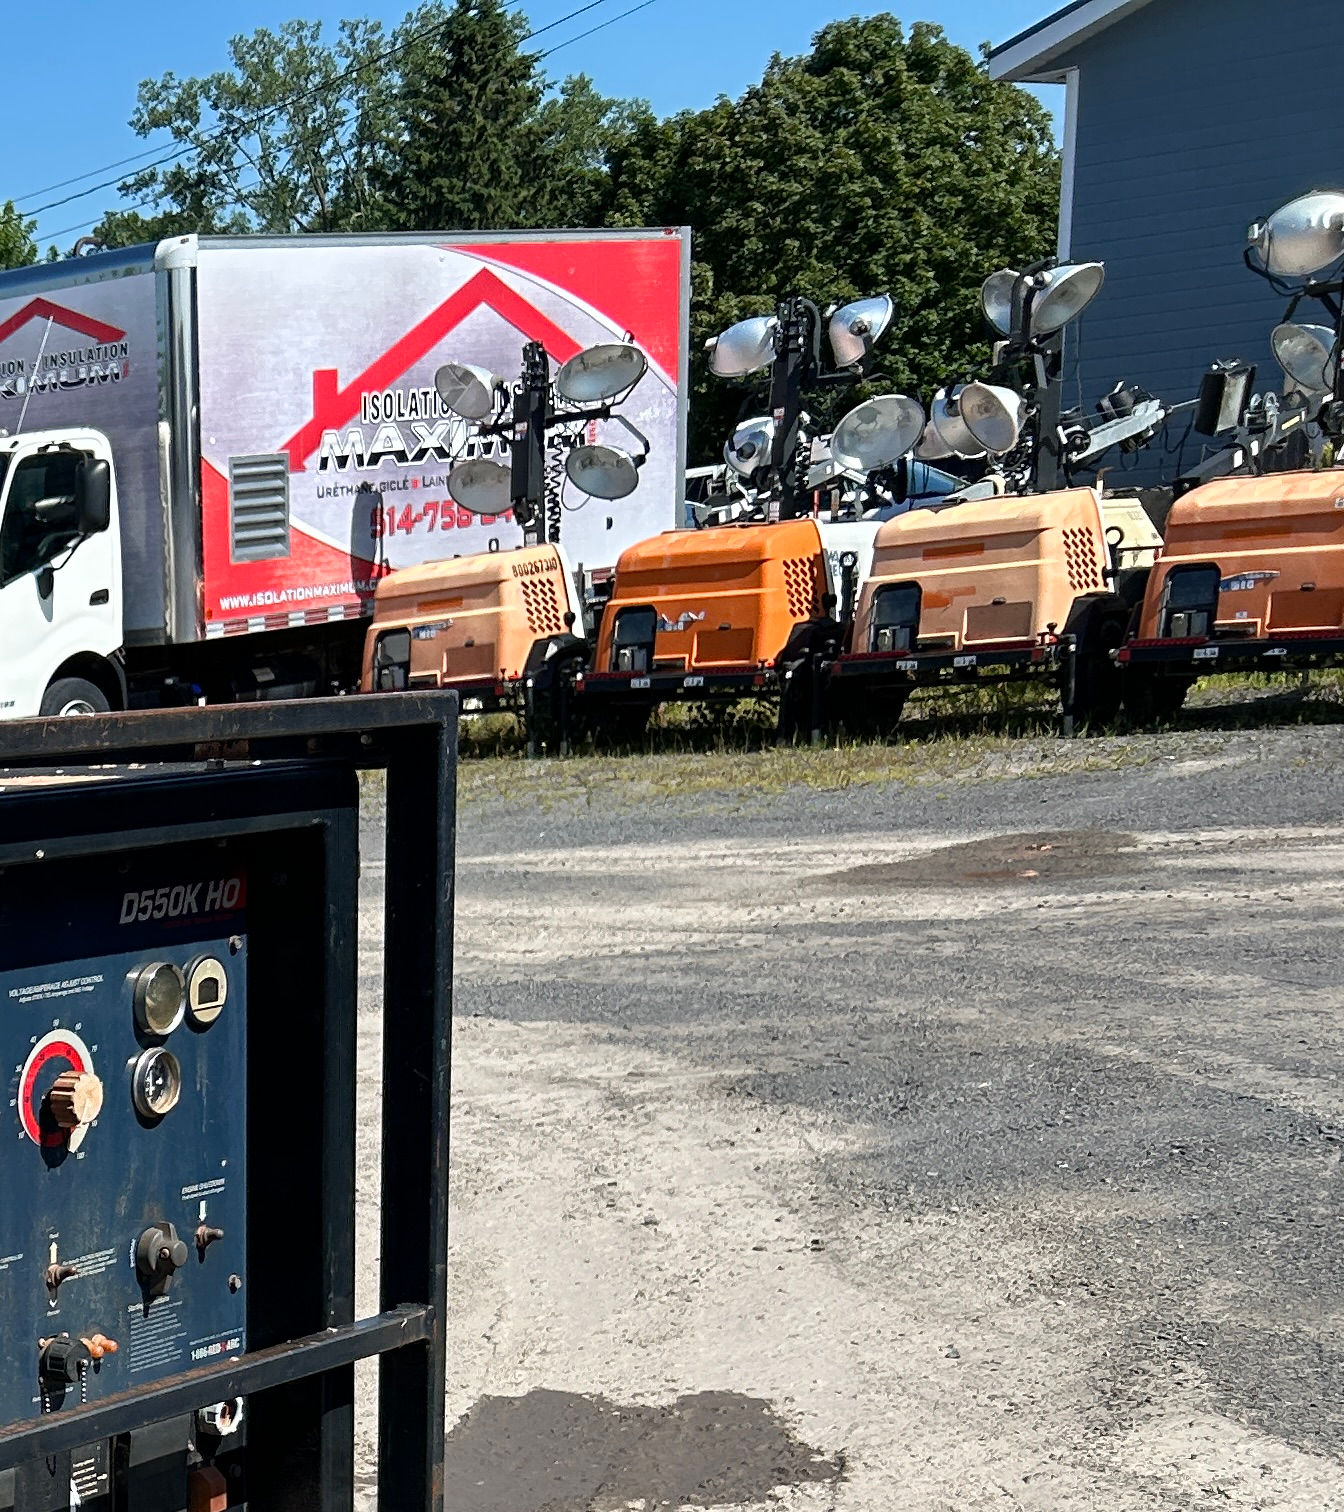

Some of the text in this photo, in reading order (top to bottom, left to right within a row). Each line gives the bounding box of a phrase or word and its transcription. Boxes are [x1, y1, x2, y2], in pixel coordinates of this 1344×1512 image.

[44, 341, 129, 369] INSULATION
[363, 387, 450, 423] ISOLATI
[422, 474, 448, 489] LAIN
[219, 578, 378, 611] WWW.ISOLATIONMAXIMUM.C
[119, 881, 203, 925] D550K
[204, 878, 241, 912] HO
